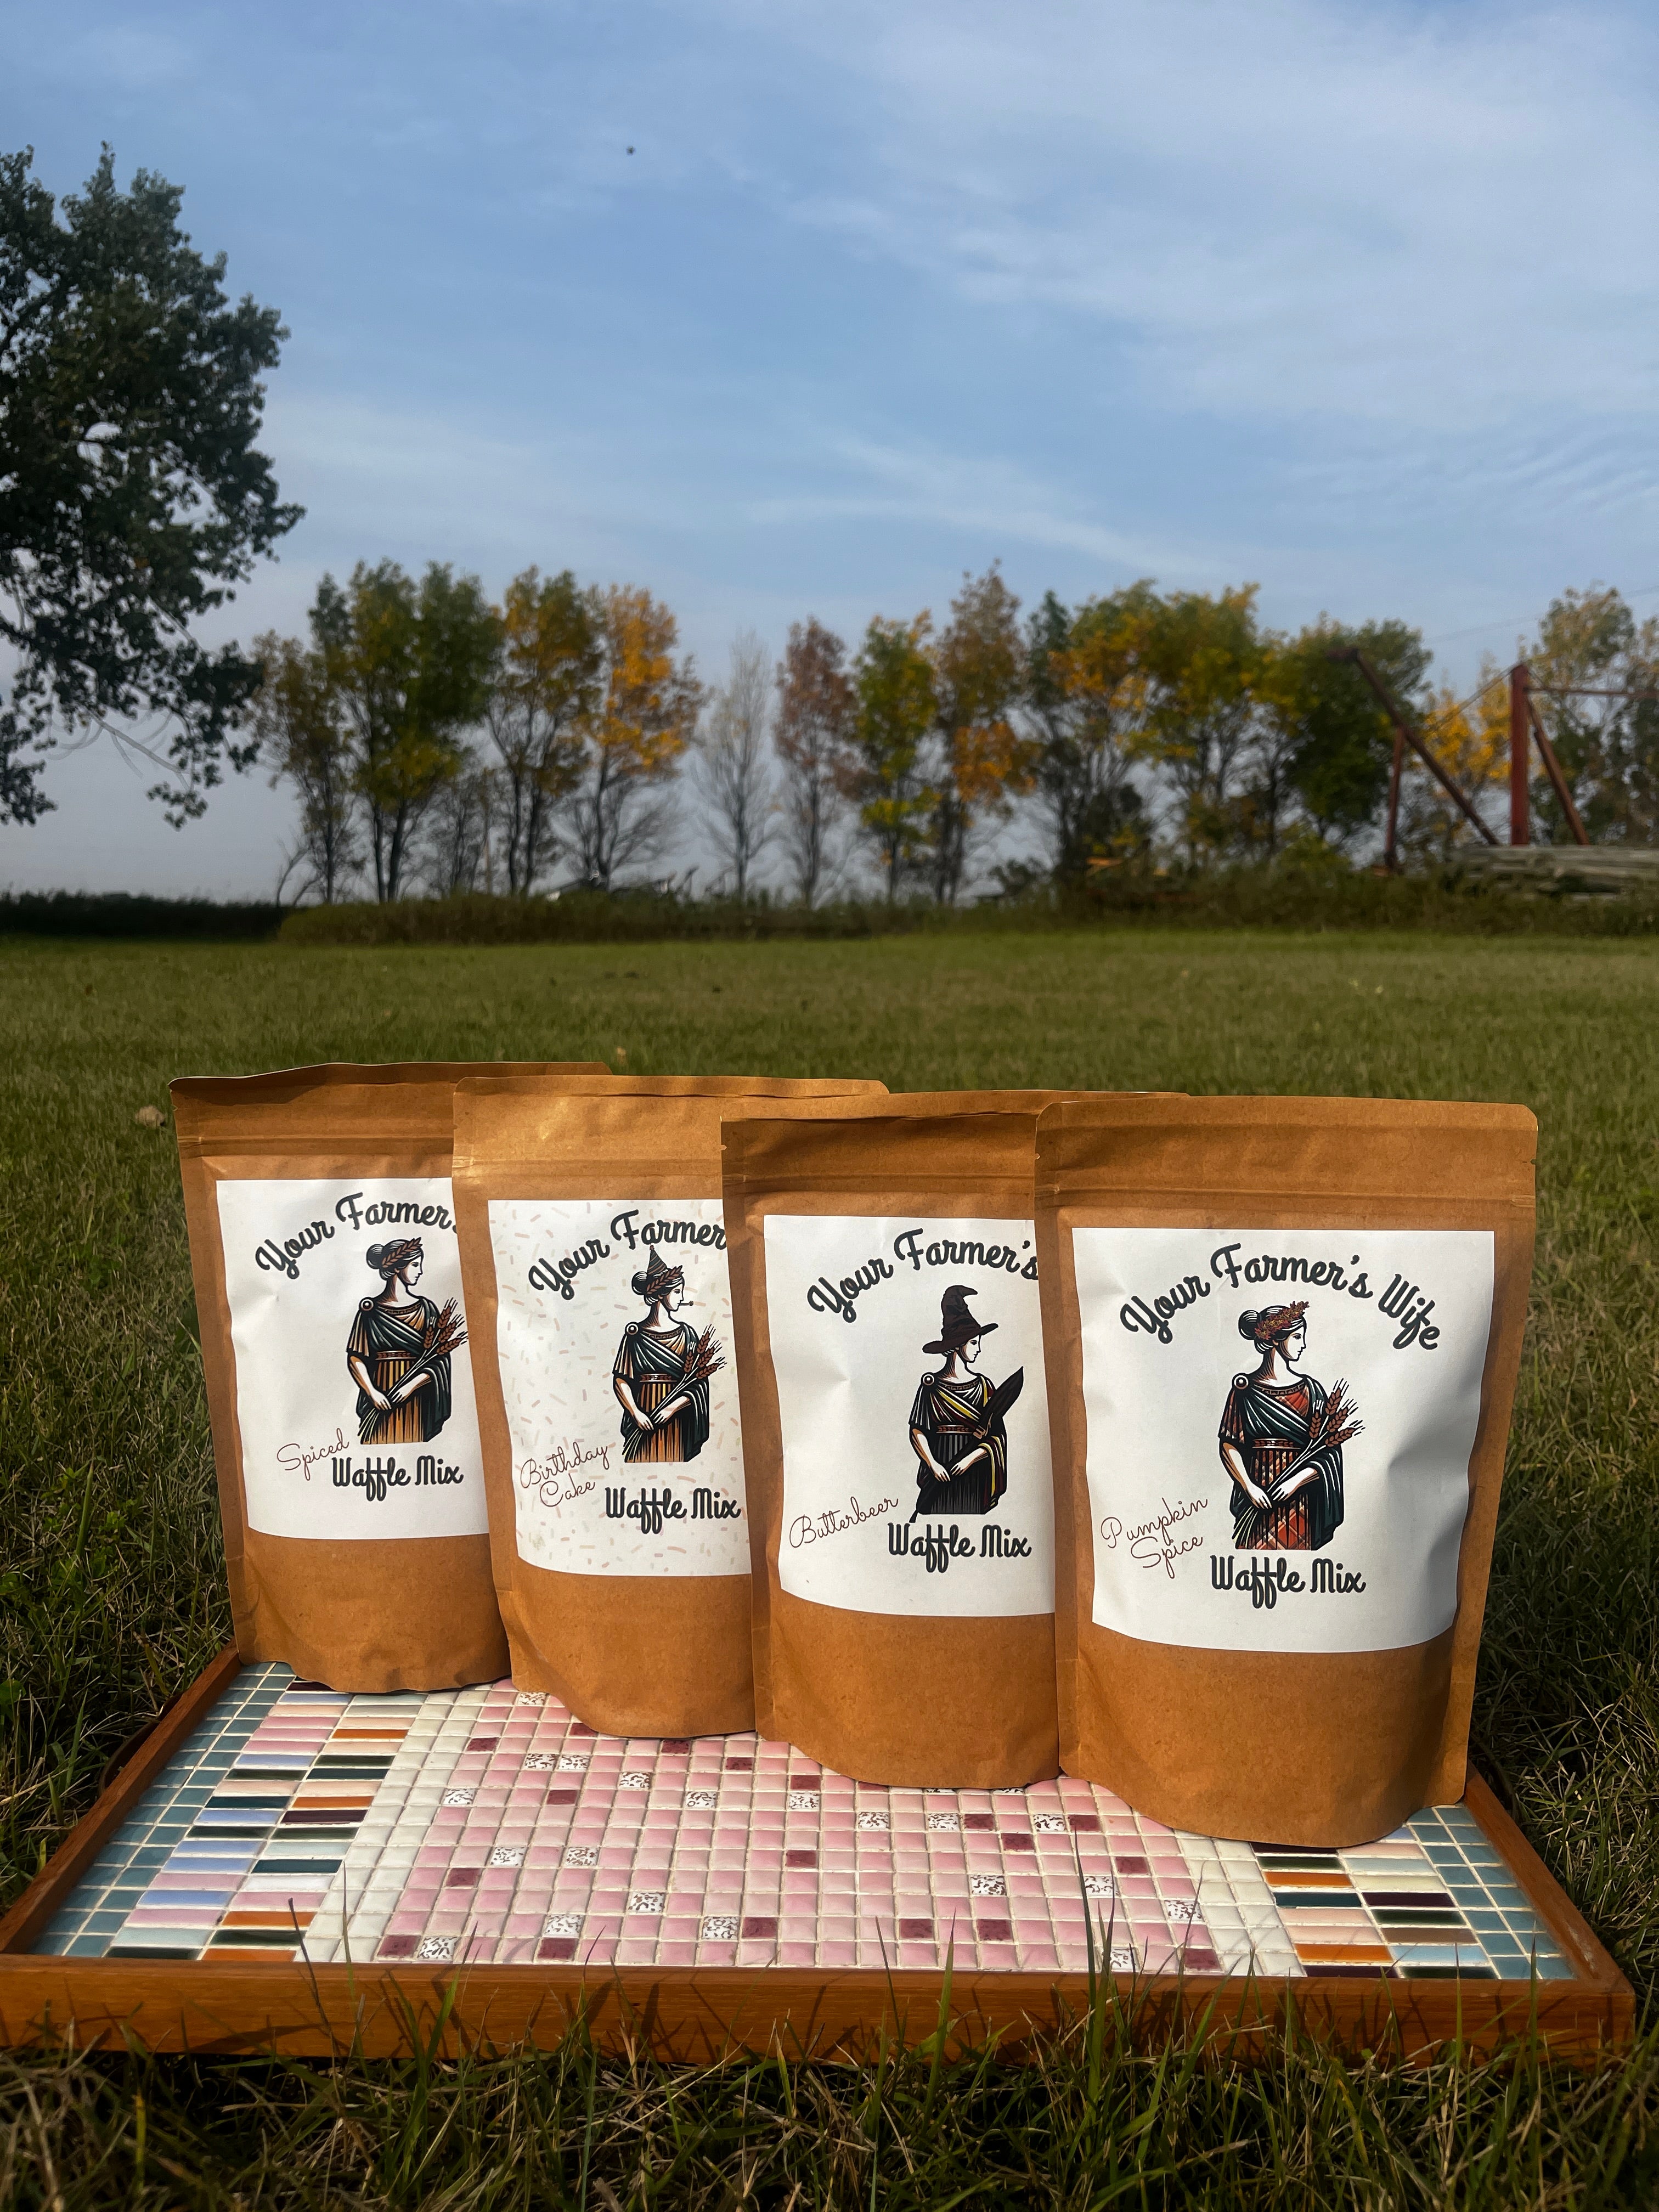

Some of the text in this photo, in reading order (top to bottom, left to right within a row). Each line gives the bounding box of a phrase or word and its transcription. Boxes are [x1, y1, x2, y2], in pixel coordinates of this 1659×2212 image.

[255, 1192, 457, 1279] Your Farmer
[528, 1239, 610, 1300] Your
[807, 1227, 1039, 1323] Your Farmer's
[1120, 1243, 1441, 1350] Your Farmer's Wife
[276, 1427, 349, 1481] Spiced
[331, 1455, 464, 1502] Waffle Mix
[520, 1441, 610, 1489] Birthday
[539, 1472, 596, 1508] Cake
[605, 1487, 742, 1534] Waffle Mix
[789, 1496, 899, 1548] Butterbeer
[887, 1522, 1032, 1573] Waffle Mix
[1101, 1497, 1208, 1549] Pumpkin
[1130, 1536, 1203, 1579] Spice
[1210, 1555, 1367, 1610] Waffle Mix
